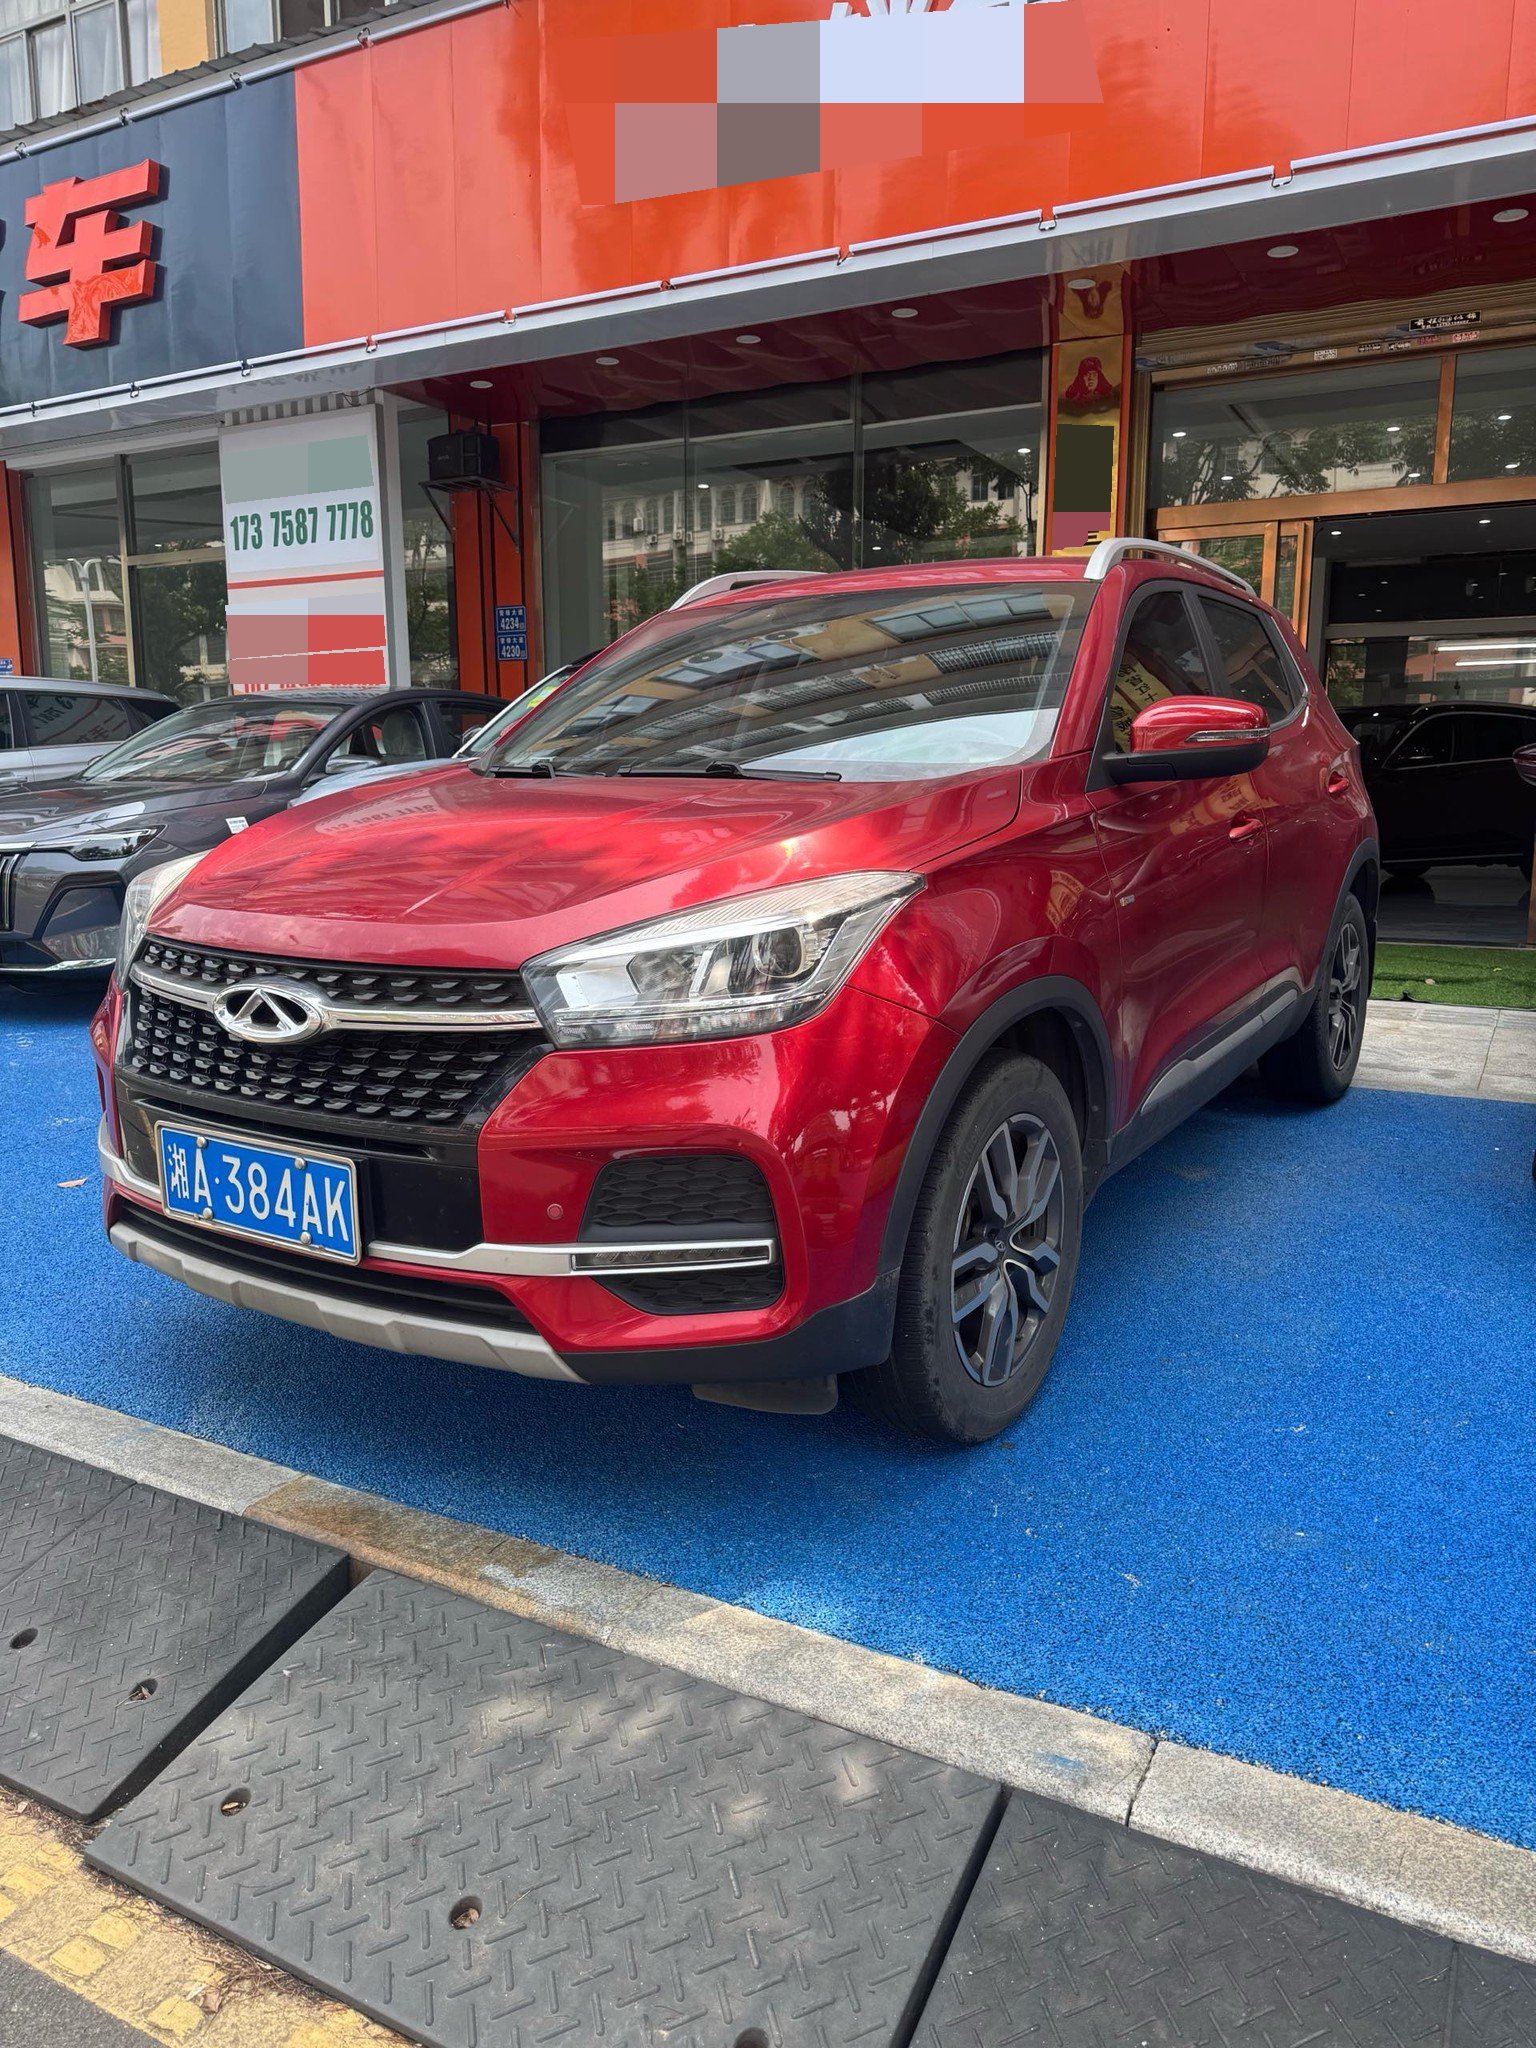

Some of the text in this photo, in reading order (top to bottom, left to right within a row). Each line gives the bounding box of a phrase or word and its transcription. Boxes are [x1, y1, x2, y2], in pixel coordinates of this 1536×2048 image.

[18, 158, 160, 349] 车
[230, 500, 374, 551] 173 7587 7778
